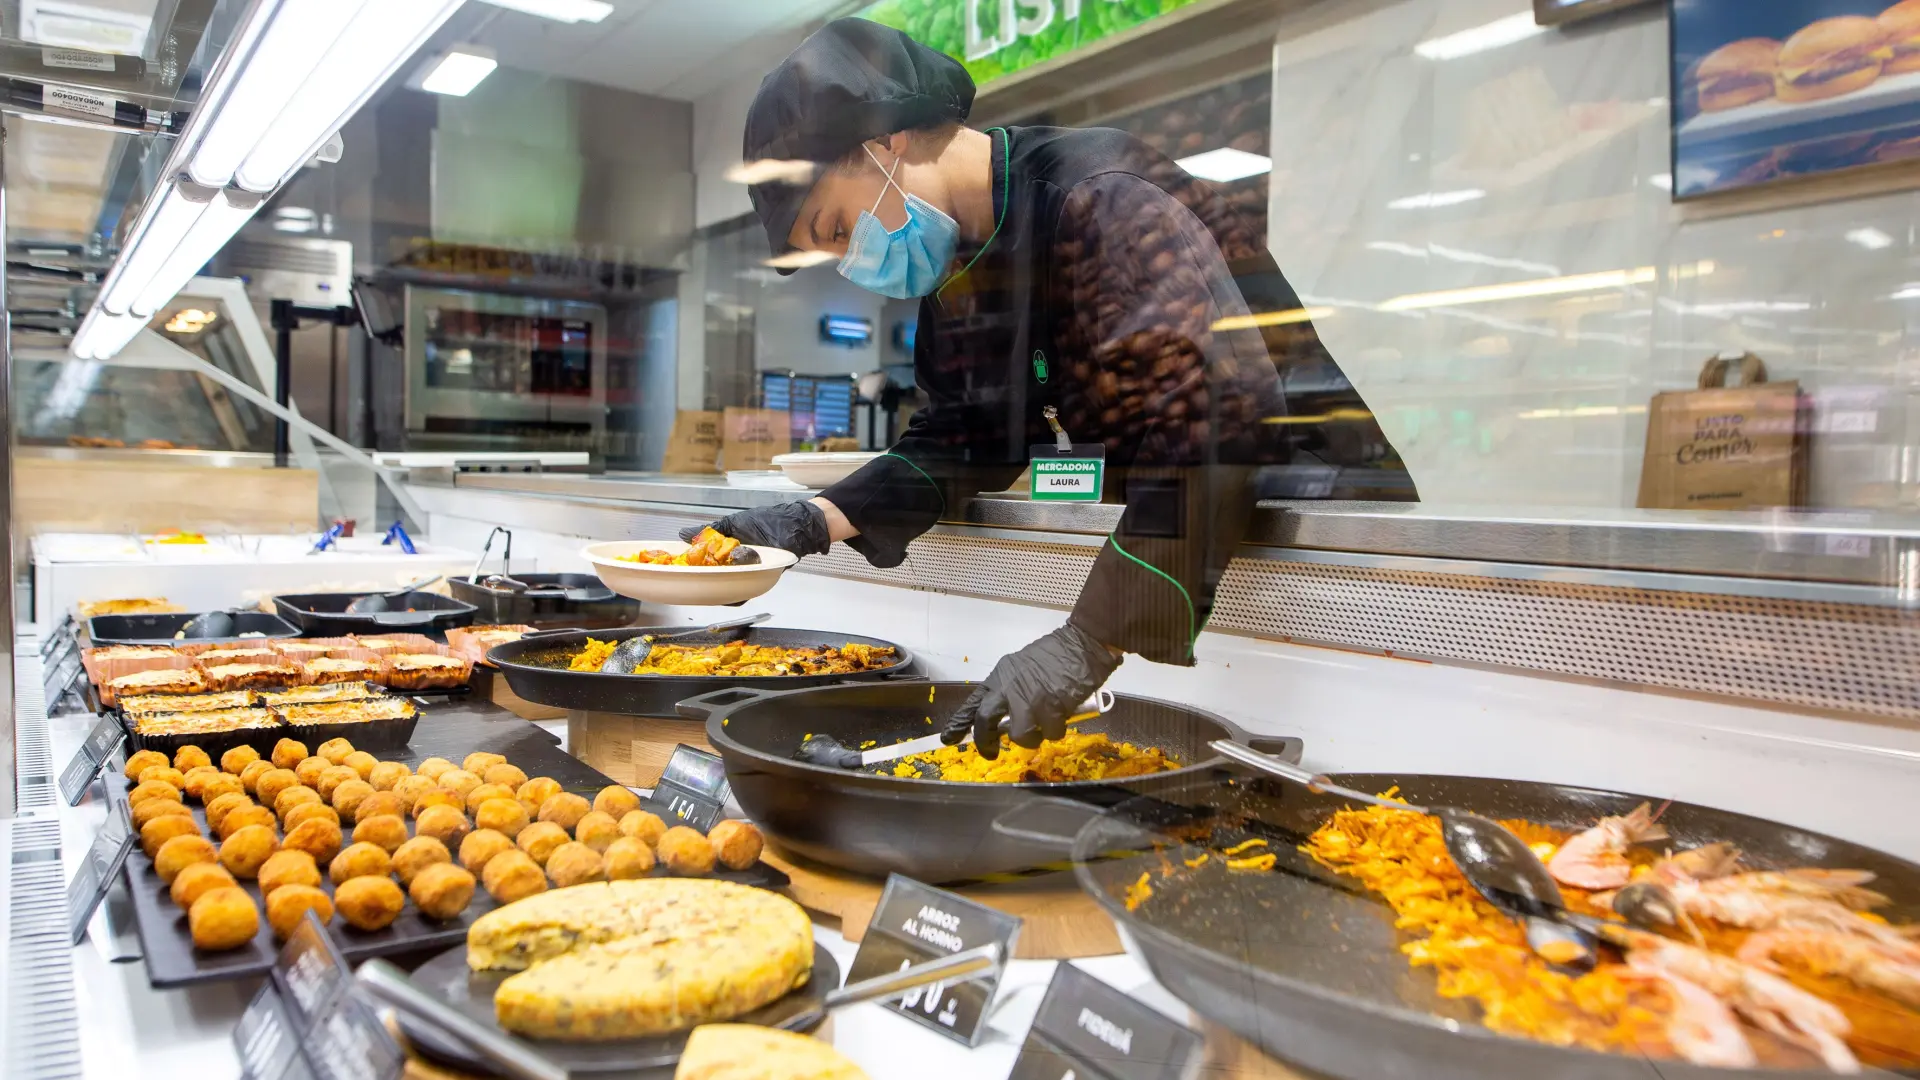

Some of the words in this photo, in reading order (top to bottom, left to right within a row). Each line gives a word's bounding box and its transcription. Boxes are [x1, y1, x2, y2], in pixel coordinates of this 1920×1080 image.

[1694, 427, 1742, 442] PARA
[1677, 436, 1757, 465] Comer
[1036, 463, 1096, 471] MERCADONA
[1050, 478, 1080, 486] LAURA
[918, 905, 960, 932] ARROZ
[902, 918, 918, 936] AL
[919, 924, 963, 952] HORNO
